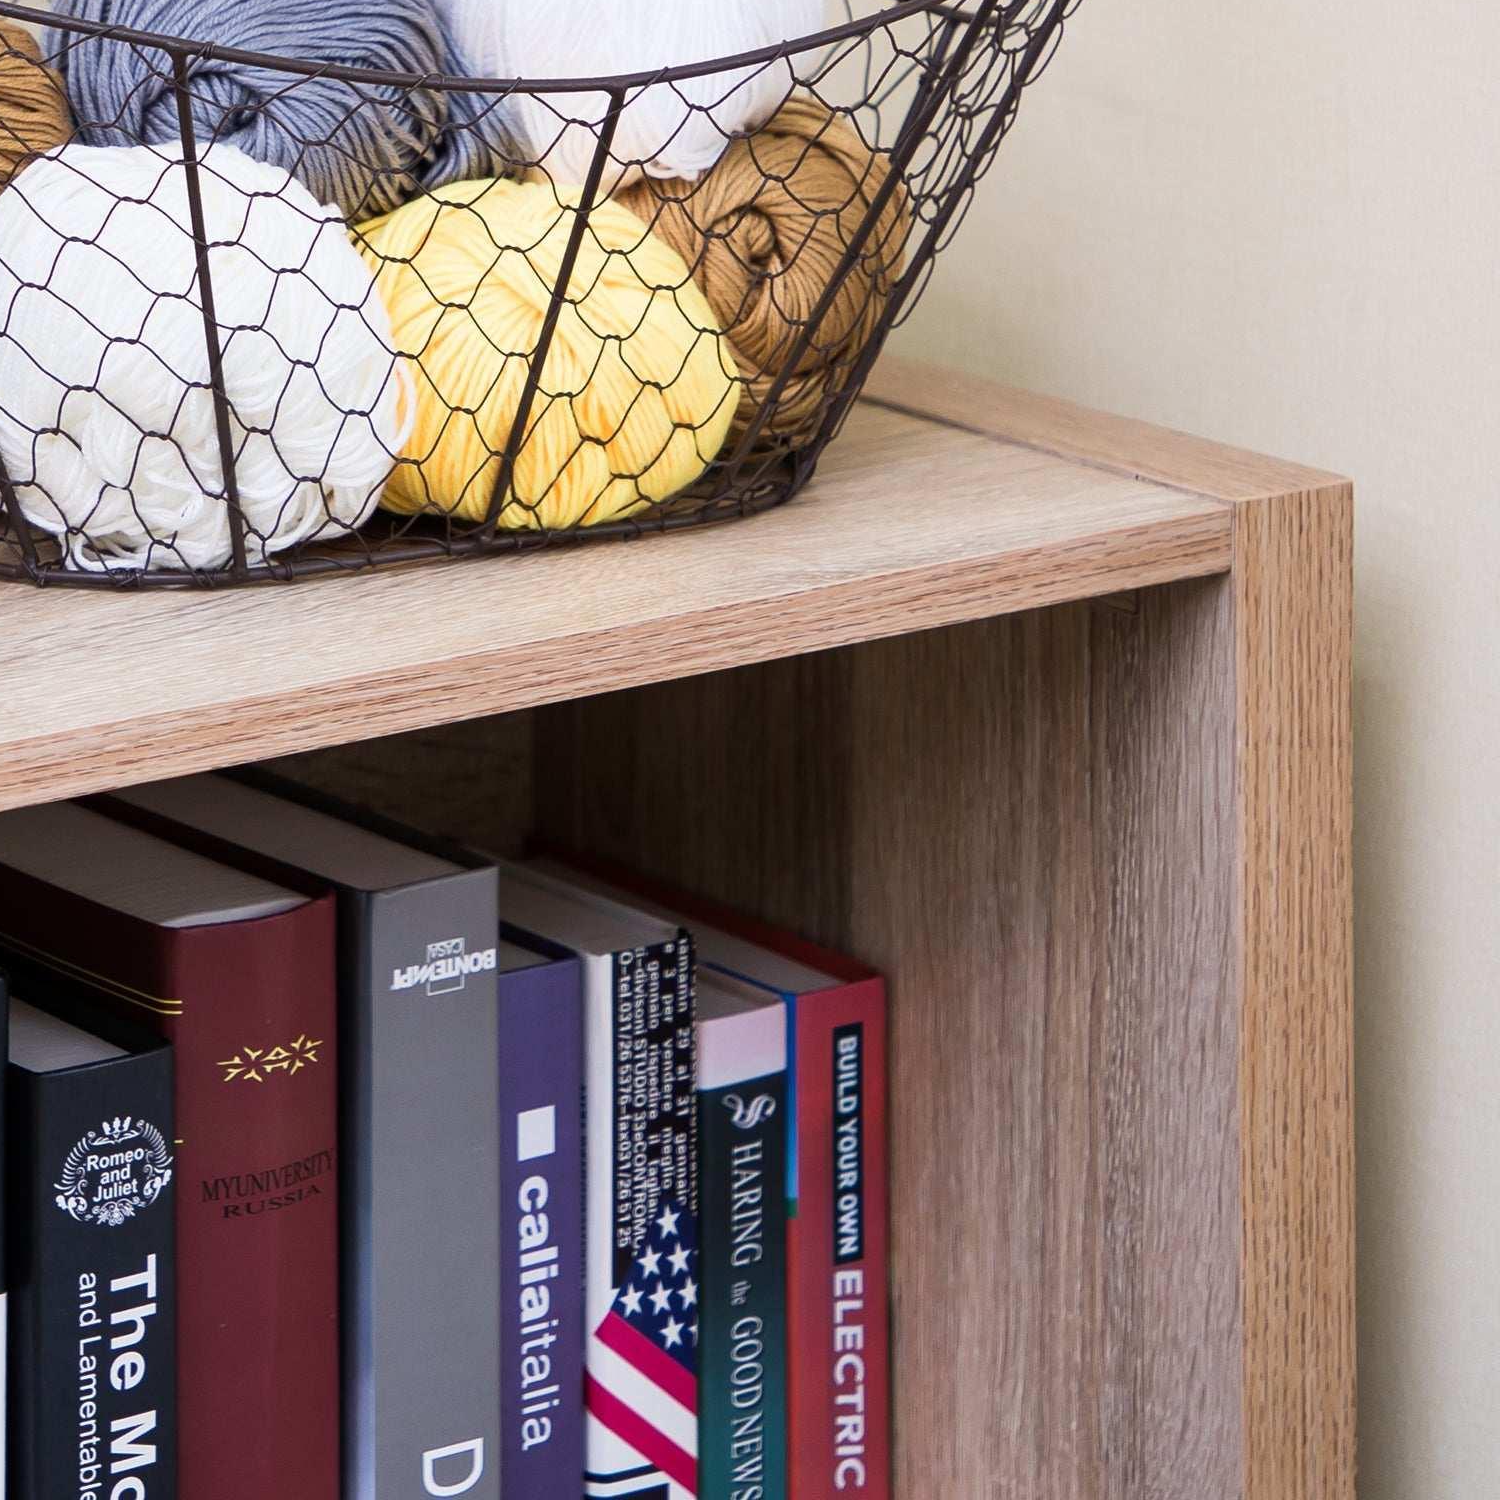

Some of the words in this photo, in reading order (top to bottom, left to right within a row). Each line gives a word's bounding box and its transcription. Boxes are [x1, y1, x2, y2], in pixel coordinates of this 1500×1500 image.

[633, 1038, 648, 1108] STUDIO
[836, 1035, 859, 1114] BUILD
[86, 1147, 145, 1171] Romeo
[100, 1163, 131, 1185] and
[199, 1147, 335, 1204] MYUNIVERSITY
[836, 1117, 859, 1190] YOUR
[92, 1179, 138, 1202] Juliet
[221, 1184, 323, 1220] RUSSIA
[730, 1139, 763, 1267] HARING
[836, 1196, 860, 1257] OWN
[79, 1272, 102, 1327] and
[109, 1252, 157, 1391] The
[518, 1174, 560, 1452] caliaitalia
[731, 1280, 751, 1306] the
[730, 1315, 763, 1409] GOOD
[833, 1268, 866, 1490] ELECTRIC
